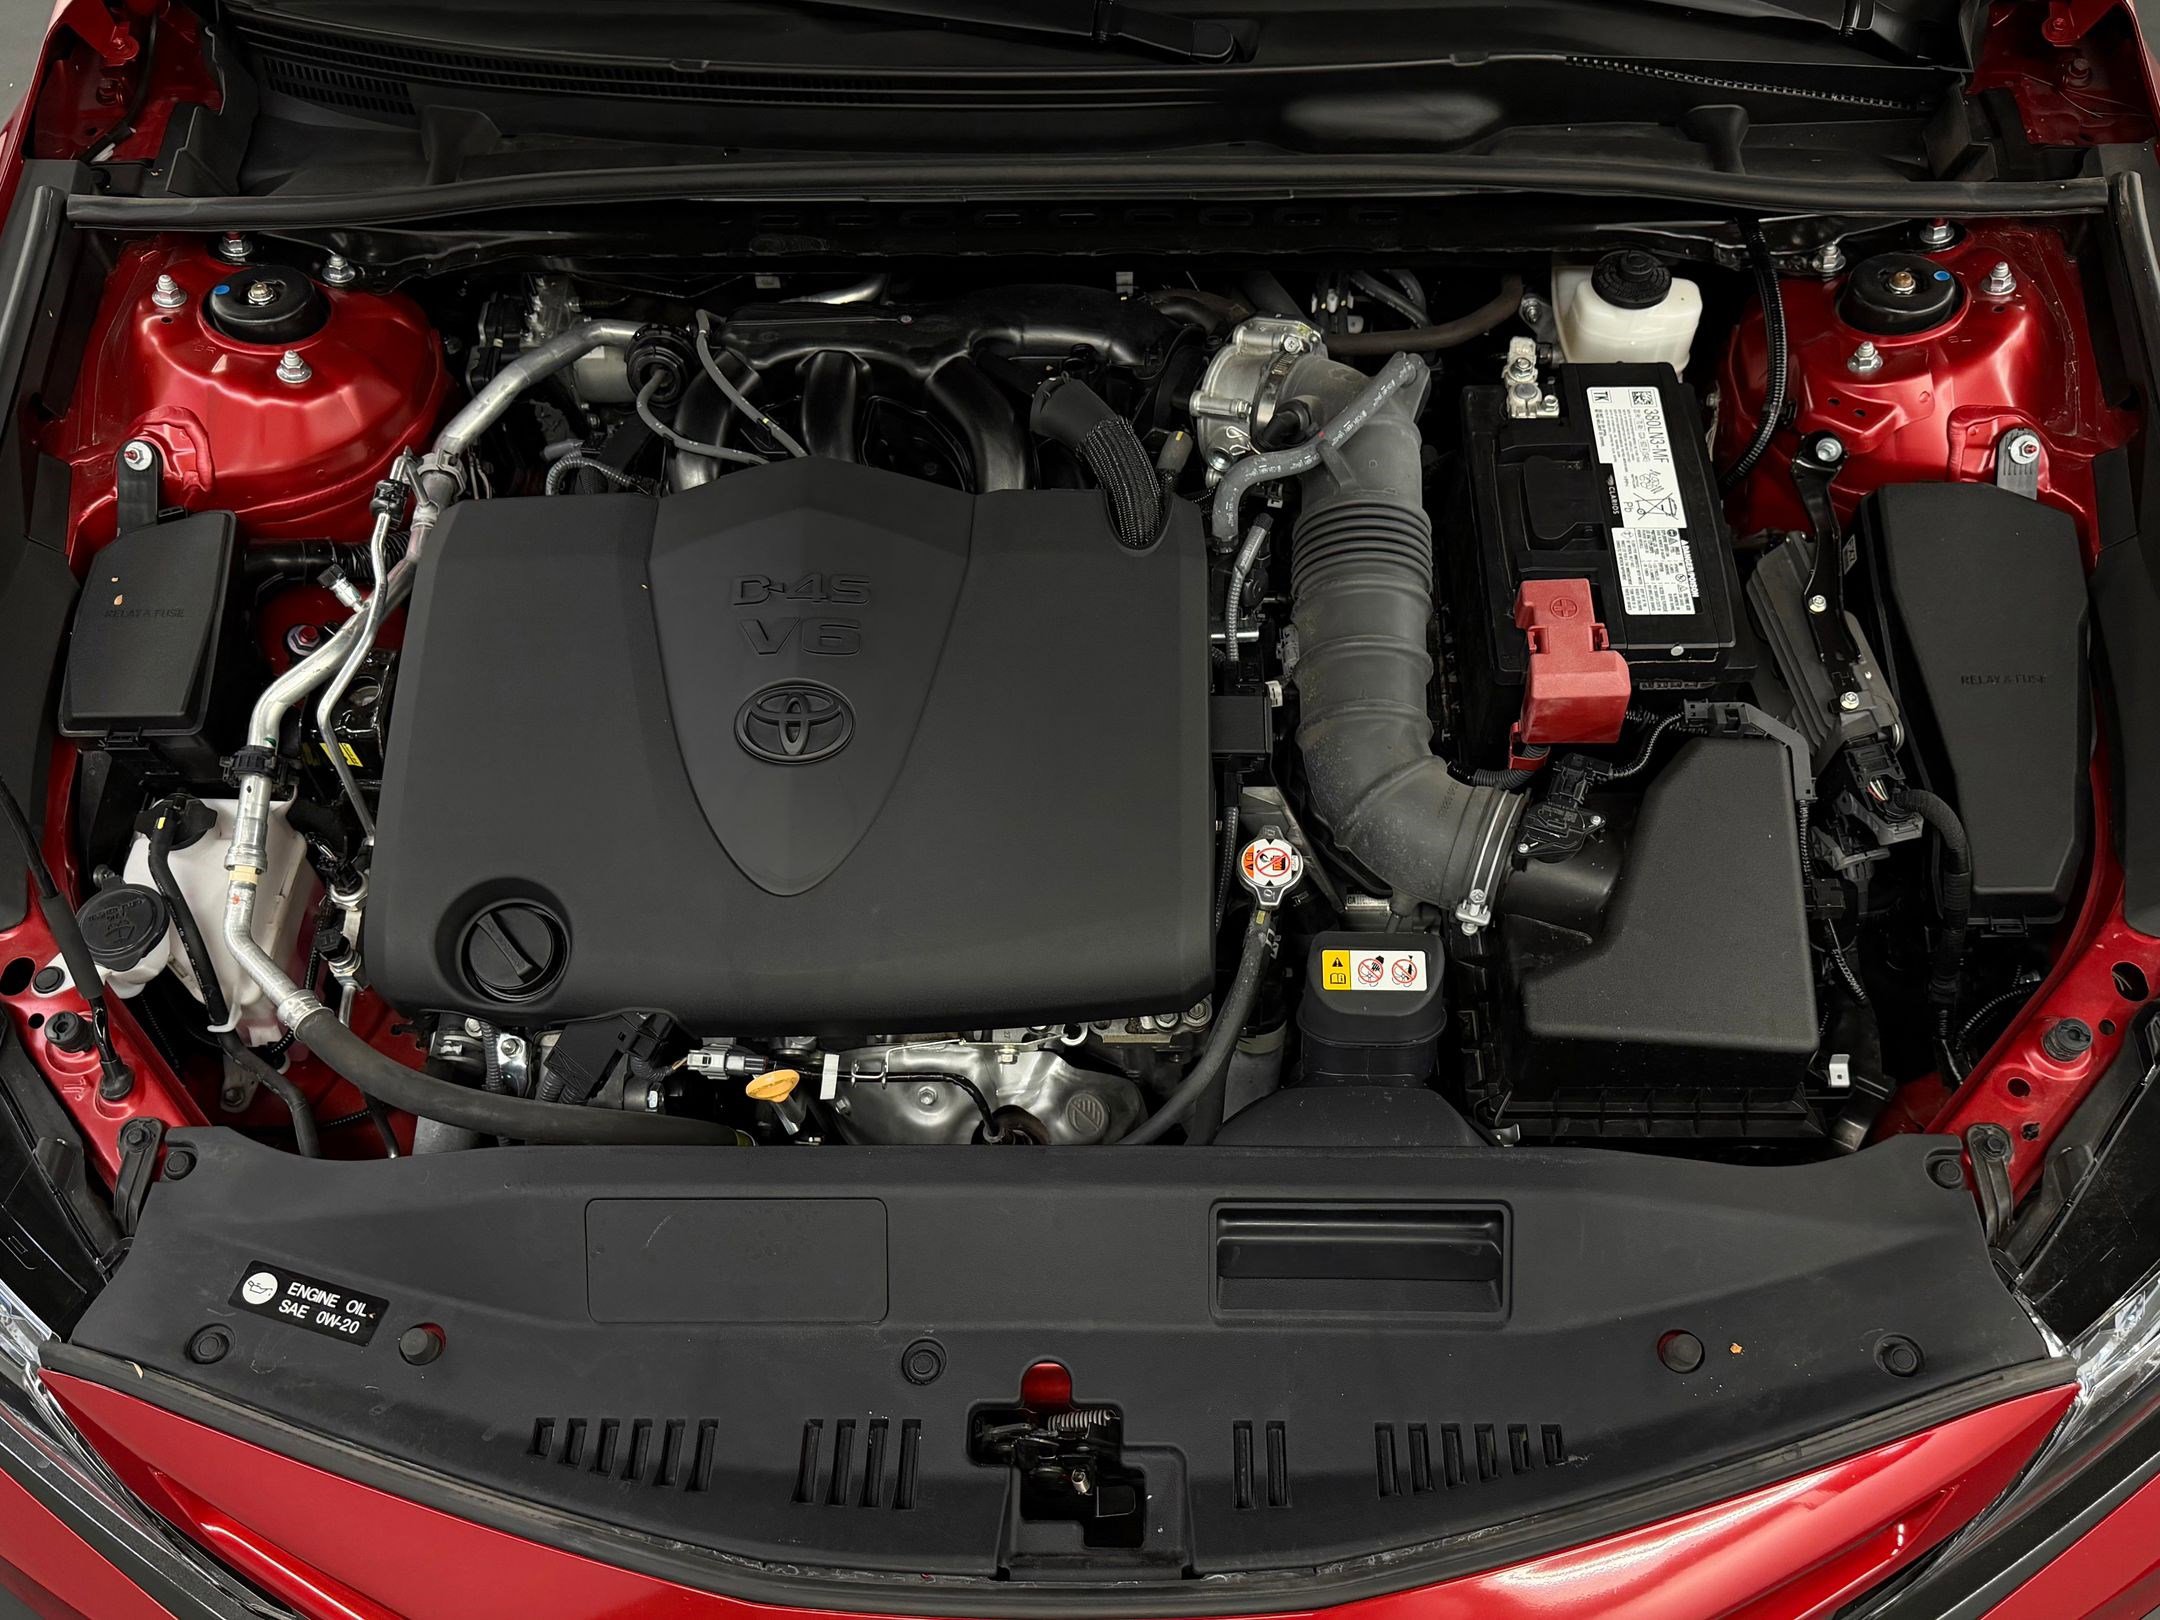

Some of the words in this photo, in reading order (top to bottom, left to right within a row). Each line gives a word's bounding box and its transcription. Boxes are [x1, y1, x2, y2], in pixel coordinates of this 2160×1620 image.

[1643, 408, 1669, 463] 380LN3-MF
[1609, 486, 1620, 515] CLARIOS
[1624, 501, 1633, 513] Pb
[739, 617, 861, 656] V6
[1960, 674, 2001, 685] RELAY
[278, 1299, 310, 1319] SAE
[315, 1310, 360, 1334] 0W-20
[287, 1281, 340, 1308] ENGINE
[345, 1300, 367, 1318] OIL
